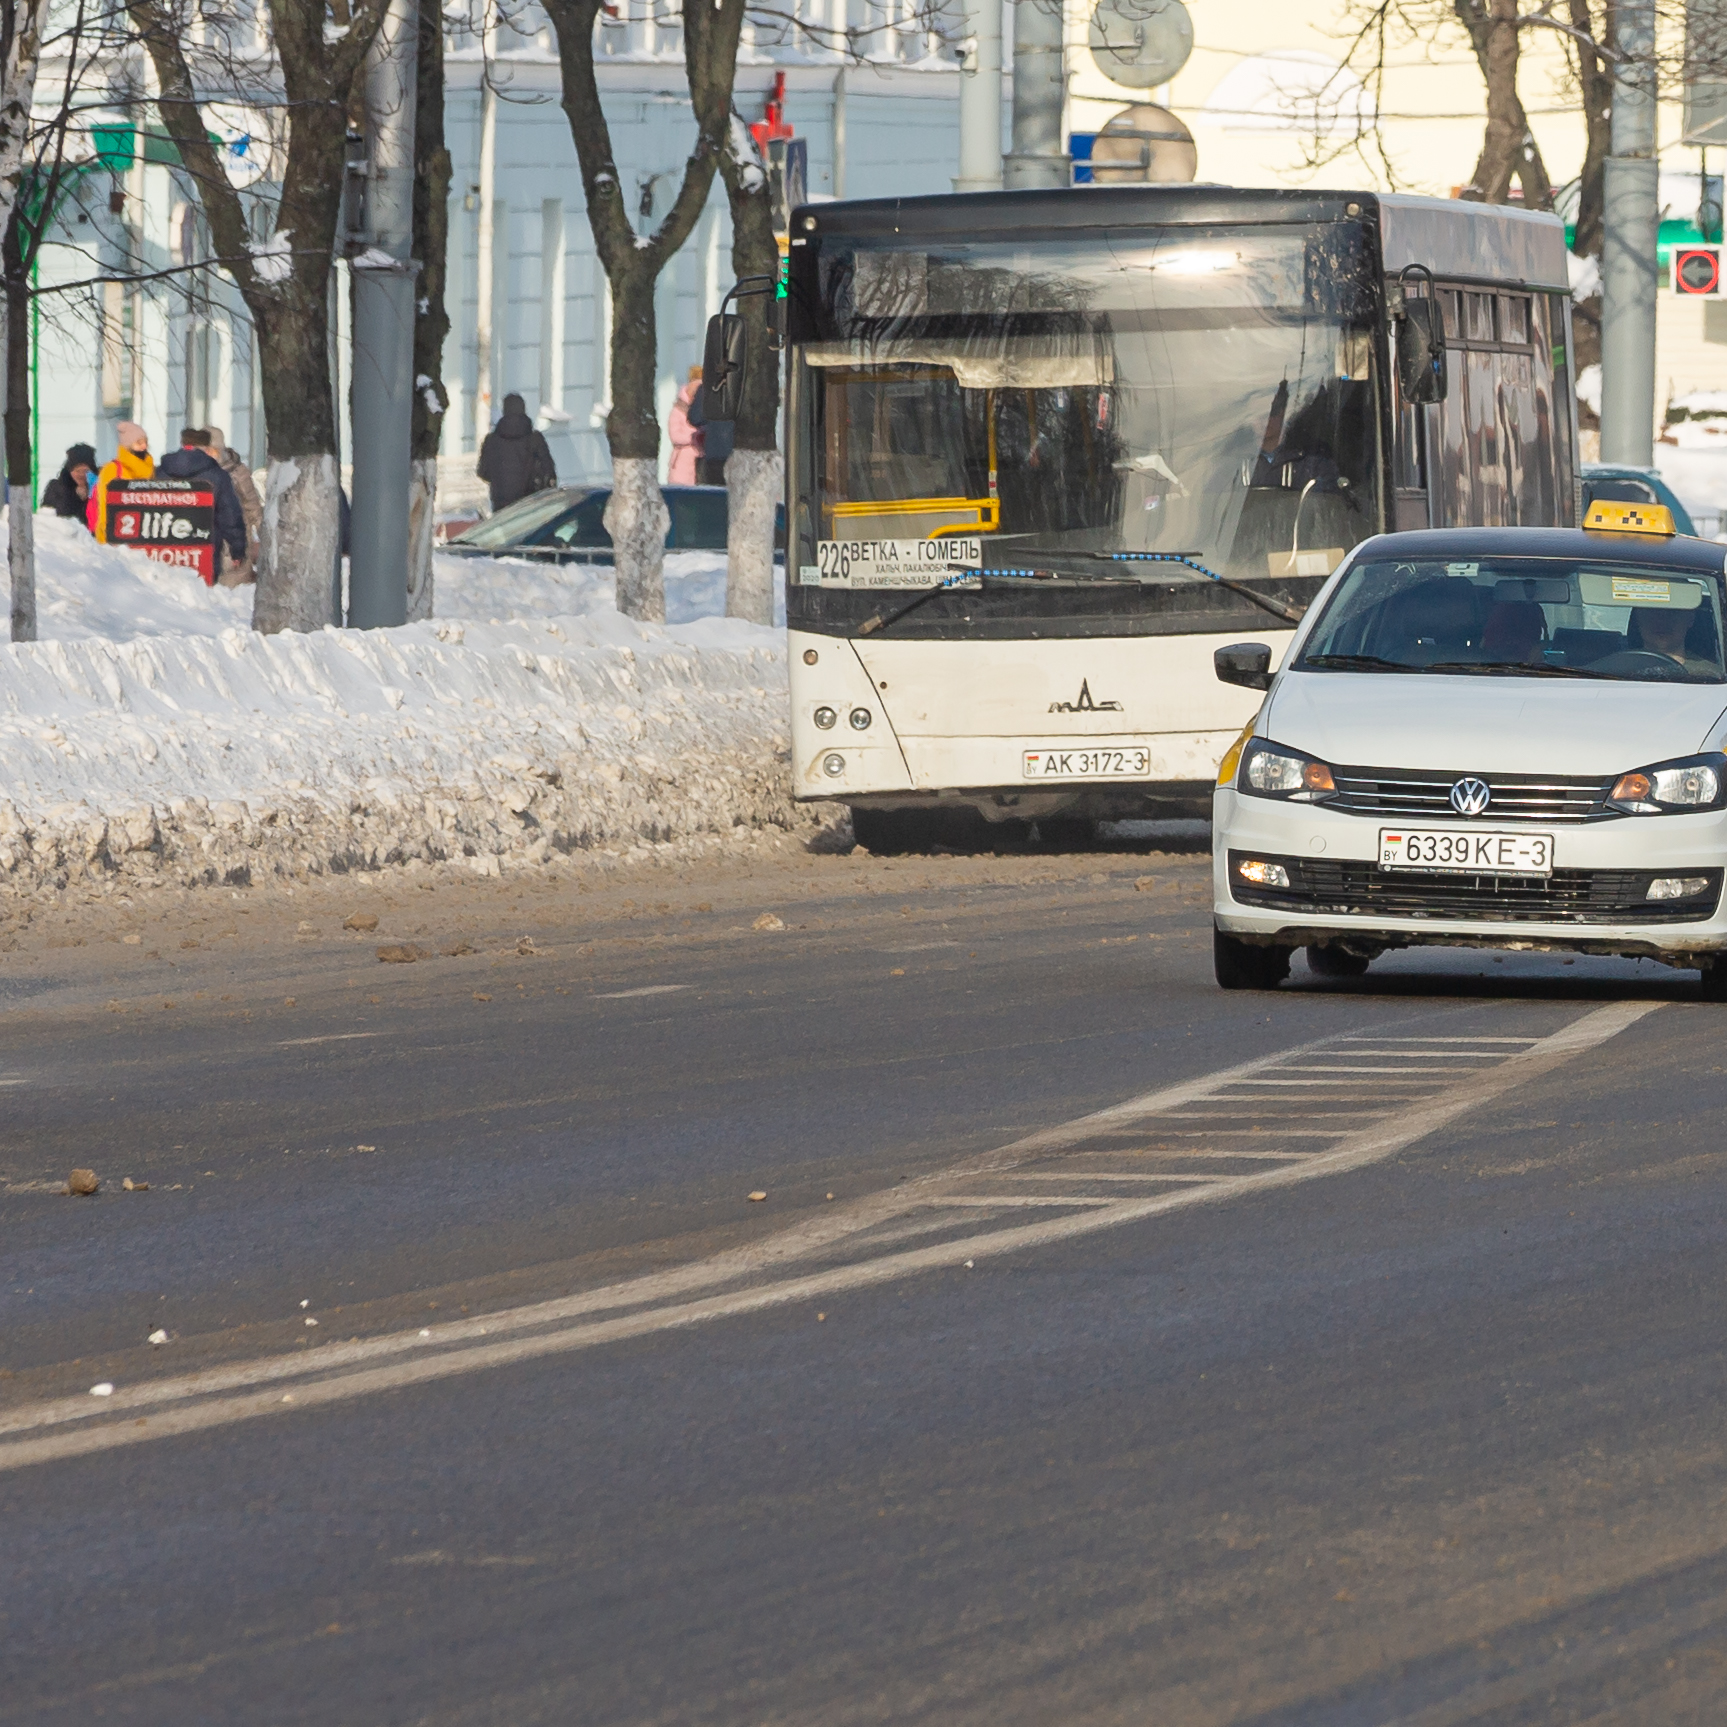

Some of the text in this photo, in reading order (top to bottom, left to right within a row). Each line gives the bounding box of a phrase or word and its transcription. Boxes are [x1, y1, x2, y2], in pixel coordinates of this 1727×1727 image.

[819, 542, 850, 578] 226
[851, 541, 899, 561] ВЕТКА
[918, 540, 980, 560] ГОМЕЛЬ
[1044, 754, 1073, 775] AK
